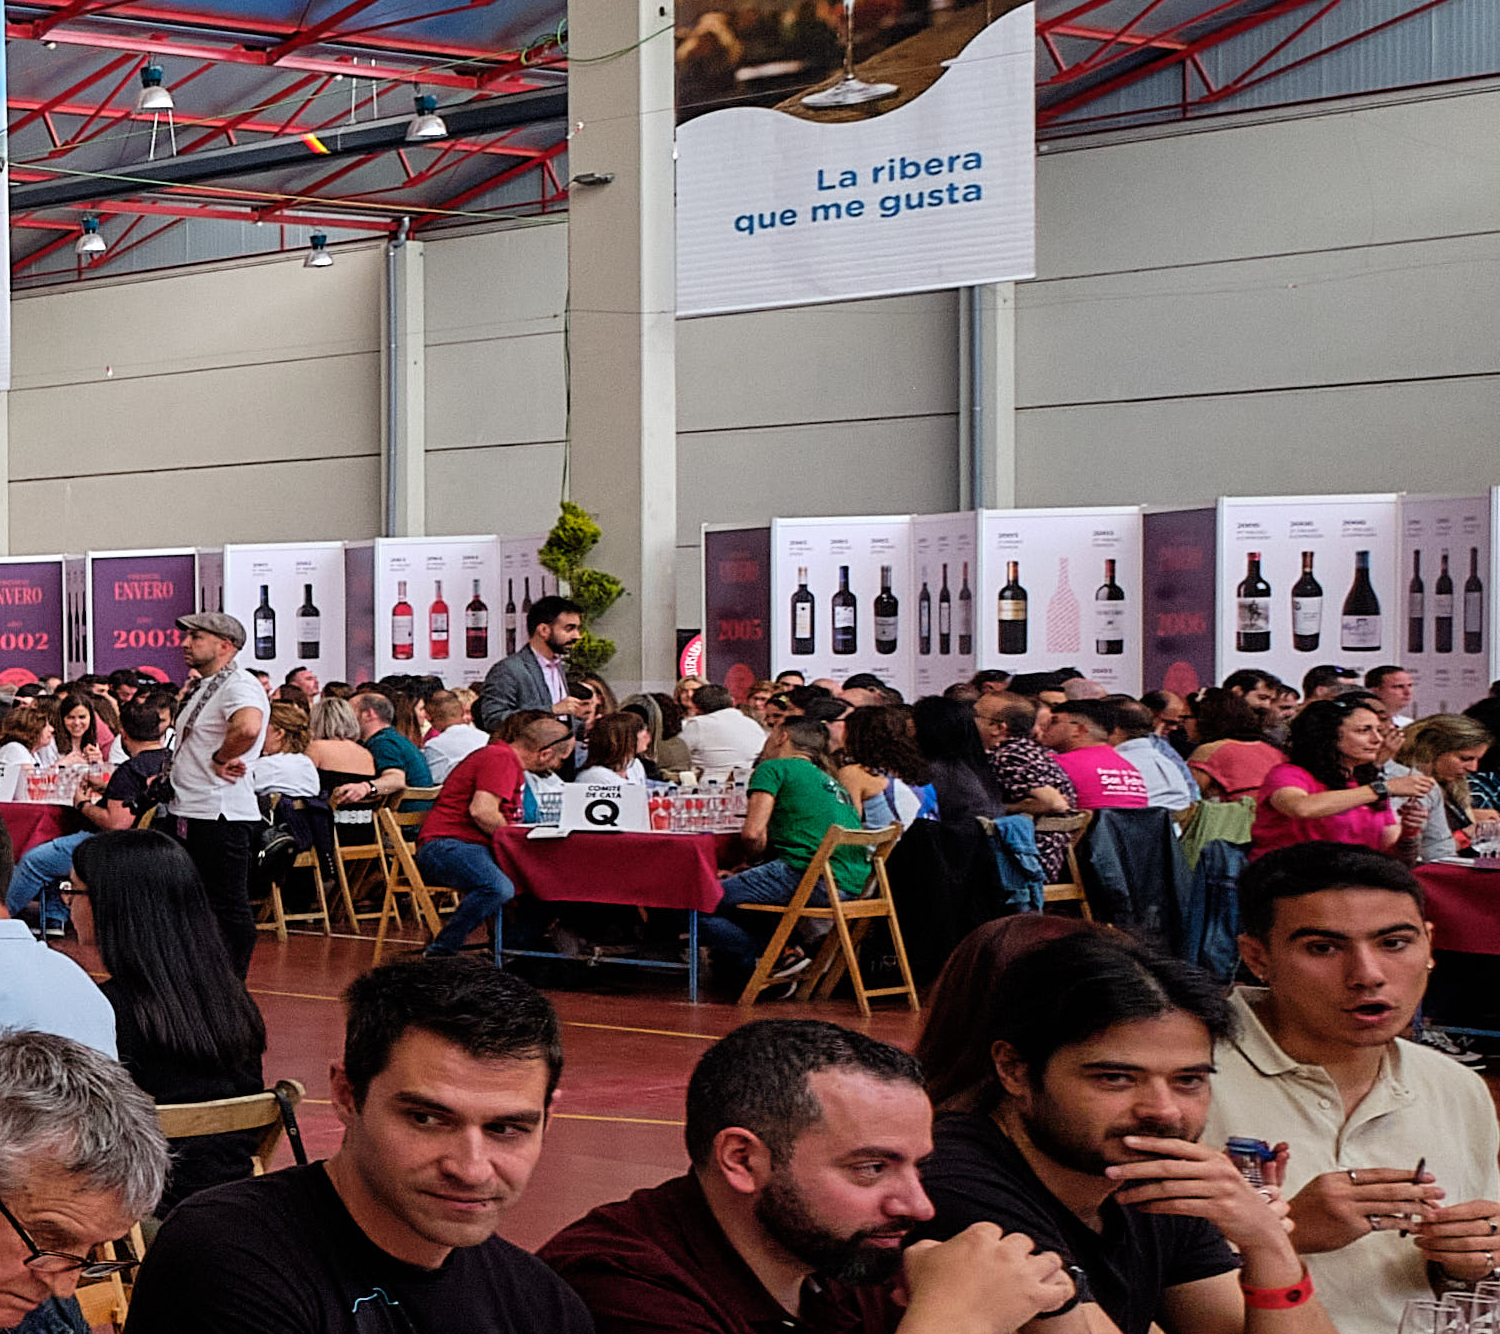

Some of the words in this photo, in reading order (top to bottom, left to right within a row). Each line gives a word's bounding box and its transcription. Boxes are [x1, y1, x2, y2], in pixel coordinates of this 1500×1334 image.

[817, 167, 858, 192] La
[871, 148, 984, 185] ribera
[734, 205, 798, 237] que
[811, 197, 866, 223] me
[880, 179, 984, 218] gusta
[114, 580, 174, 601] ENVERO
[113, 628, 181, 649] 2003
[584, 799, 619, 827] Q
